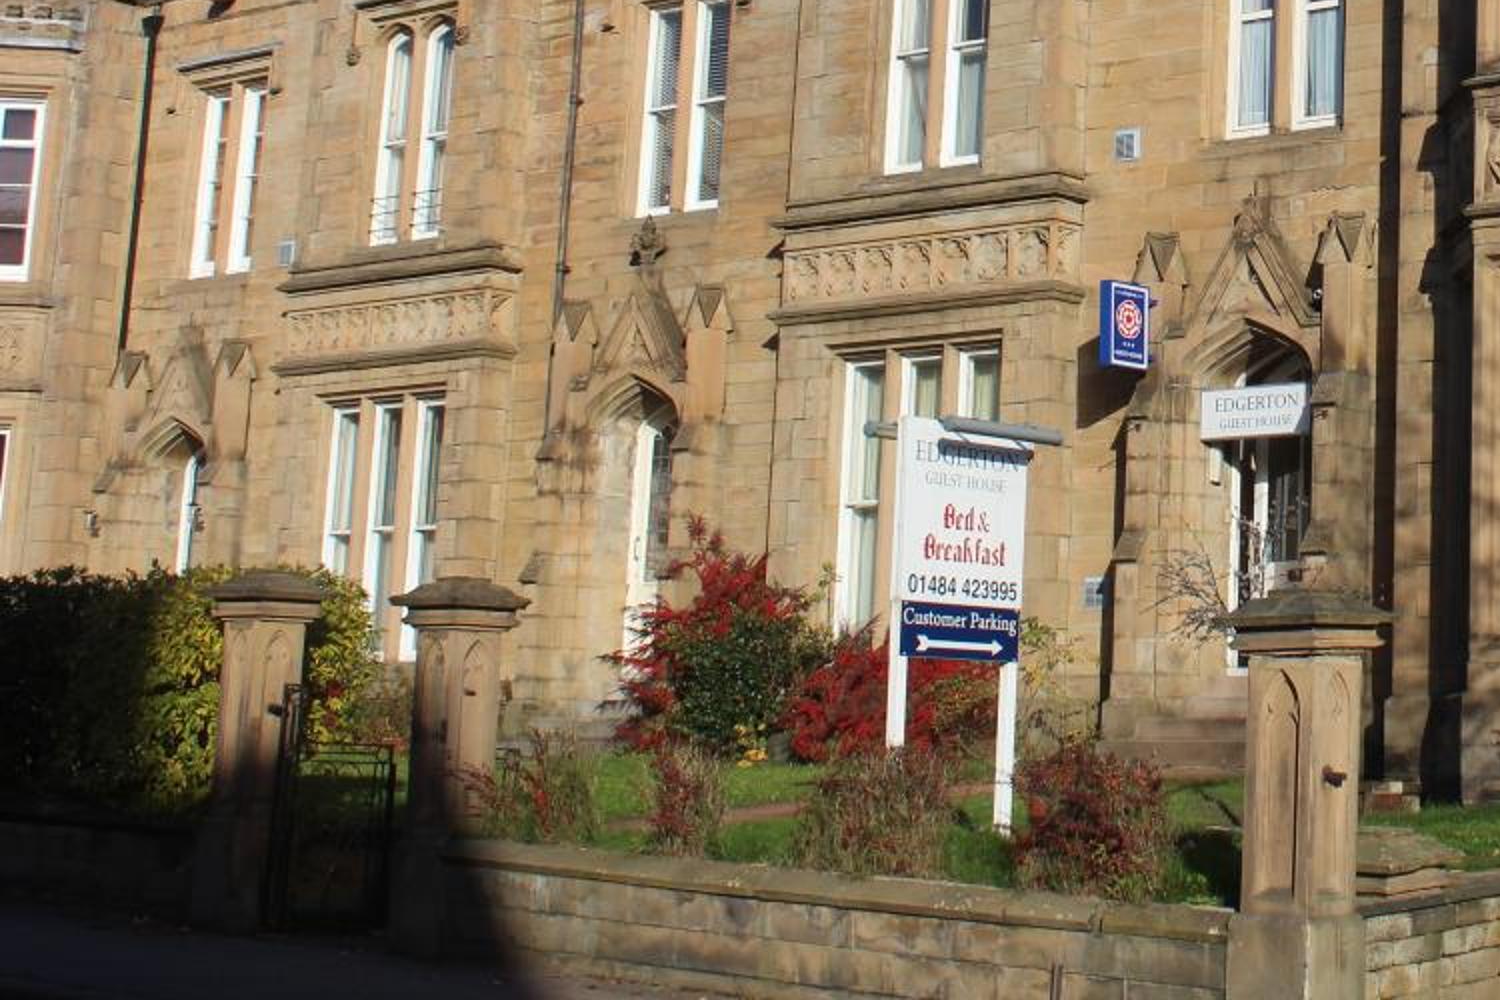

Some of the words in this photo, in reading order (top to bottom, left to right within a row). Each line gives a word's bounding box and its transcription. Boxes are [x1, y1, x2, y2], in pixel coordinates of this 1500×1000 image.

[1215, 392, 1300, 413] EDGERTON
[1219, 417, 1253, 429] GUEST
[1255, 414, 1293, 427] HOUSE
[915, 439, 1021, 473] EDGERTON
[925, 470, 962, 487] GUEST
[967, 475, 1008, 493] HOUSE
[944, 503, 975, 531] Bed
[977, 511, 990, 533] &
[924, 533, 1005, 567] Breakfast
[908, 573, 957, 596] 01484
[961, 579, 1017, 601] 423995
[903, 607, 966, 628] Customer
[970, 611, 1017, 637] Parking
